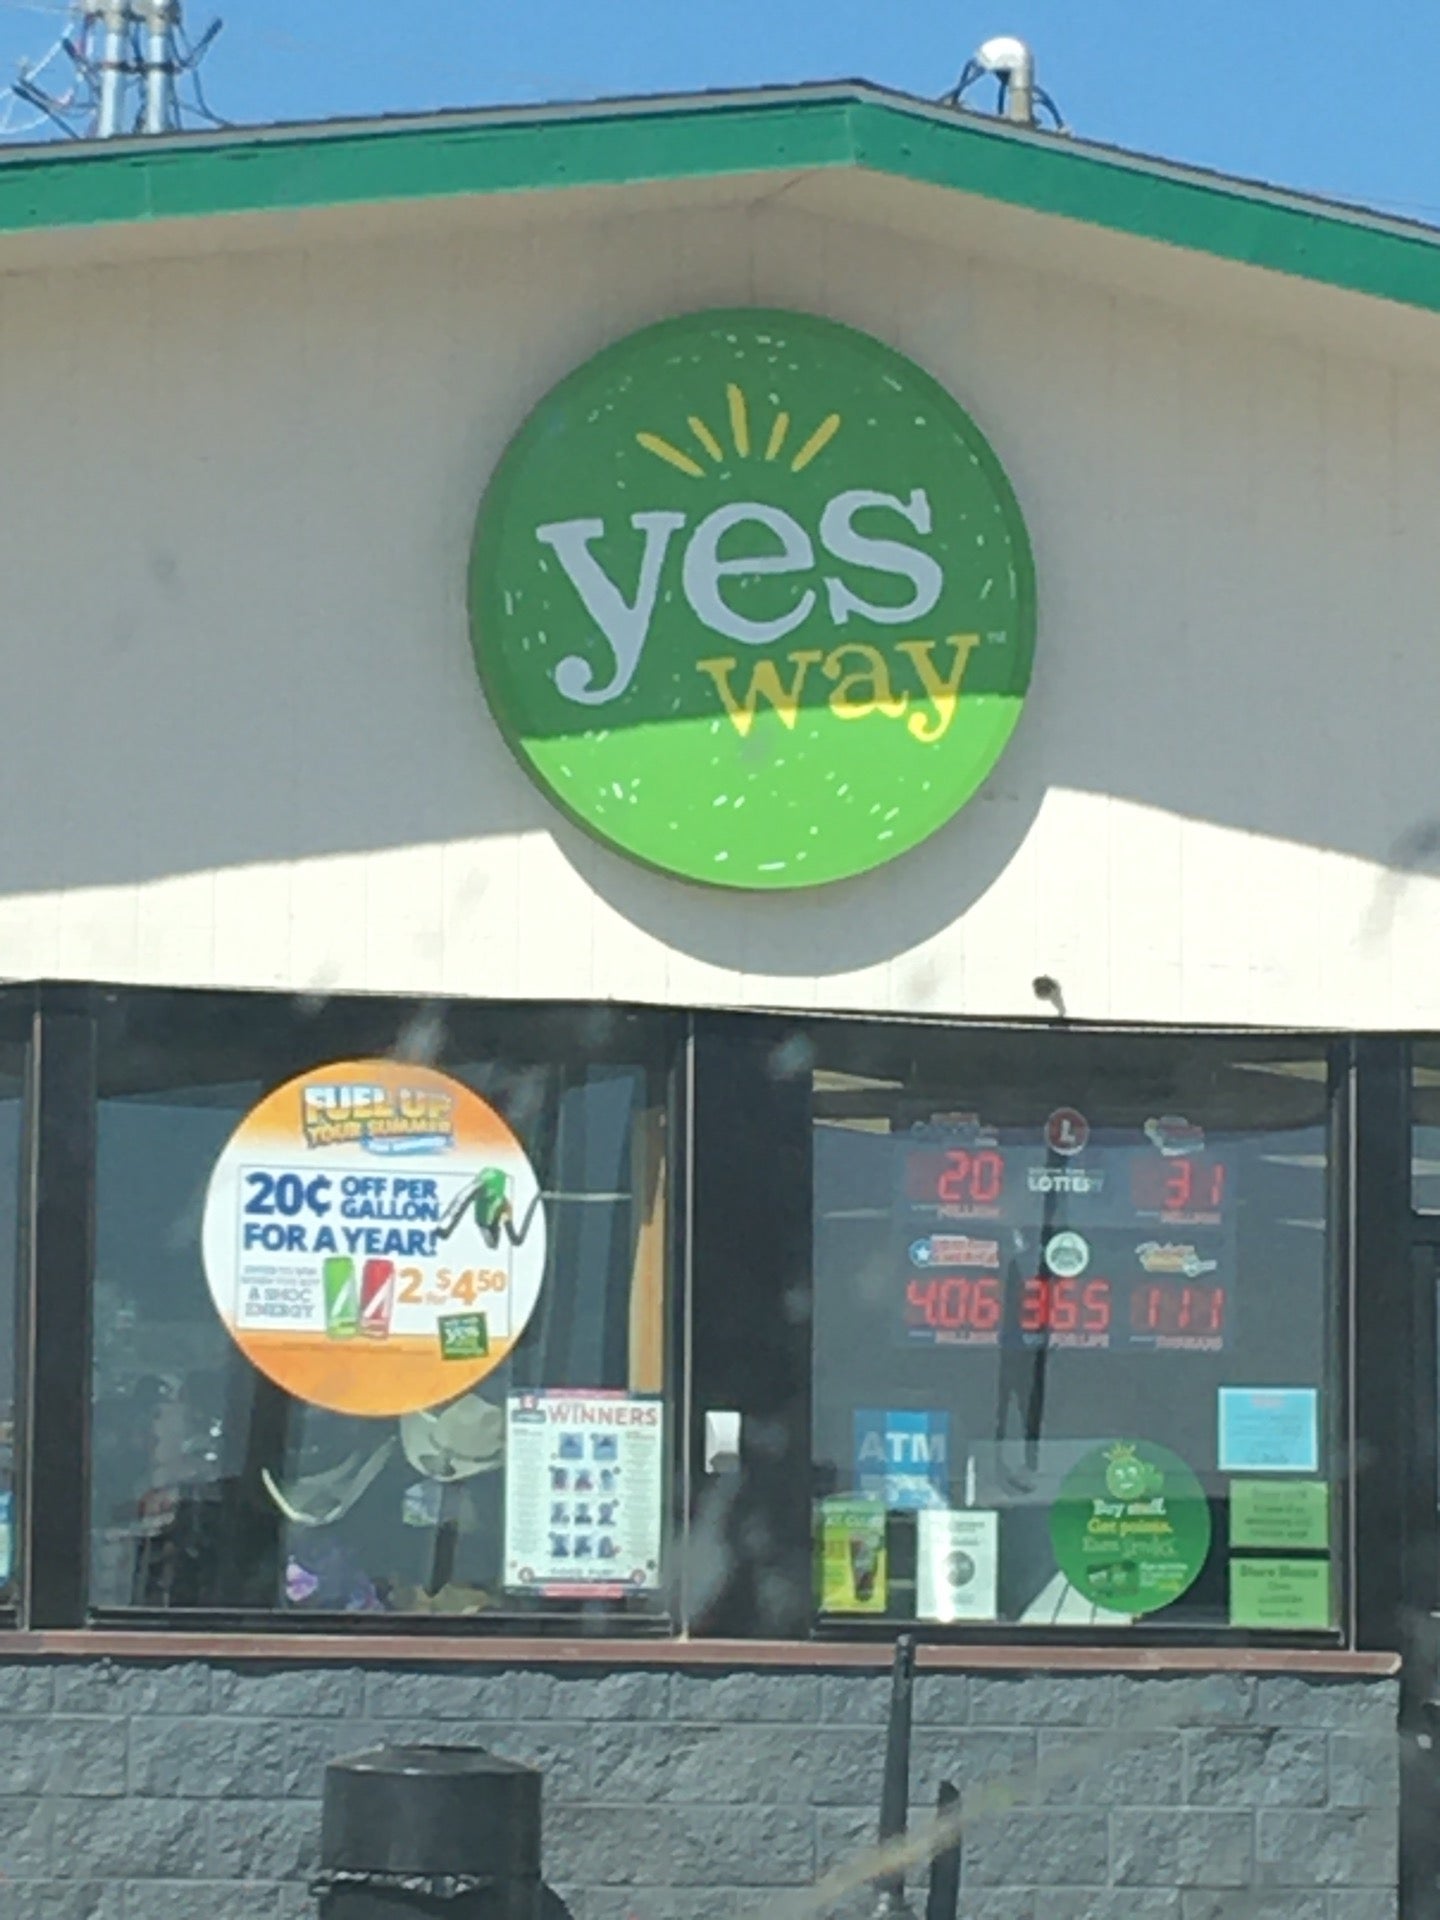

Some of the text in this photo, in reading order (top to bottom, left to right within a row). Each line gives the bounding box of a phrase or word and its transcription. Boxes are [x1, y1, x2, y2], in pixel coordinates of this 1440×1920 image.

[536, 489, 943, 705] yes
[696, 633, 980, 743] way
[304, 1085, 452, 1123] FUEL UP
[341, 1175, 438, 1200] OFF PER
[937, 1147, 1004, 1202] 20
[1163, 1157, 1224, 1210] 31
[244, 1171, 333, 1218] 20¢
[341, 1198, 440, 1222] GALLON
[244, 1222, 438, 1257] FOR A YEAR!
[398, 1267, 423, 1304] 2
[906, 1276, 1001, 1330] 406
[1020, 1276, 1111, 1332] 365
[548, 1404, 657, 1427] WINNERS
[858, 1430, 947, 1464] ATM
[1093, 1498, 1125, 1518] Buy
